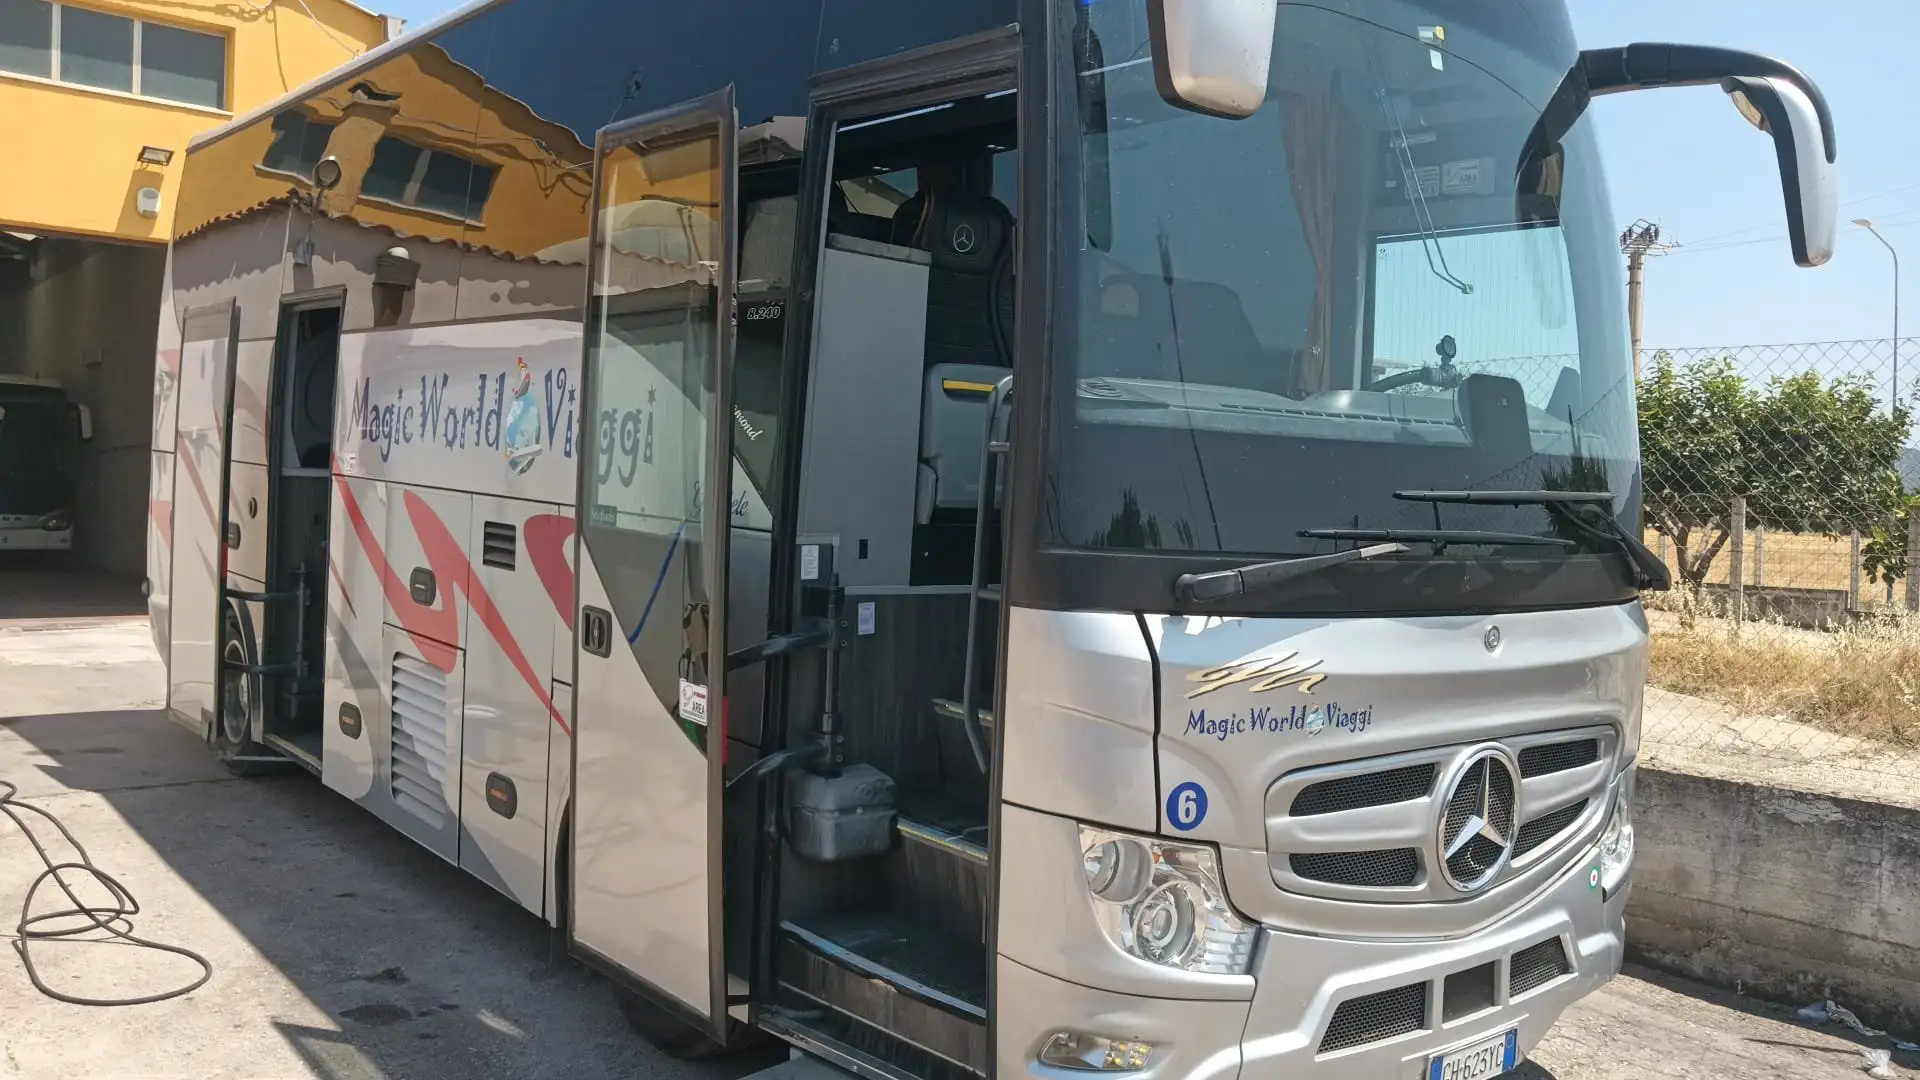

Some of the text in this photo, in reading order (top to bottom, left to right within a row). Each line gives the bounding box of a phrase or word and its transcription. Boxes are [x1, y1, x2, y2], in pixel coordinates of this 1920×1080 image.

[747, 306, 781, 320] 8.240
[347, 368, 656, 488] Magic World Viggi
[1184, 702, 1373, 741] Magic World Viaggi
[1177, 789, 1197, 824] 6
